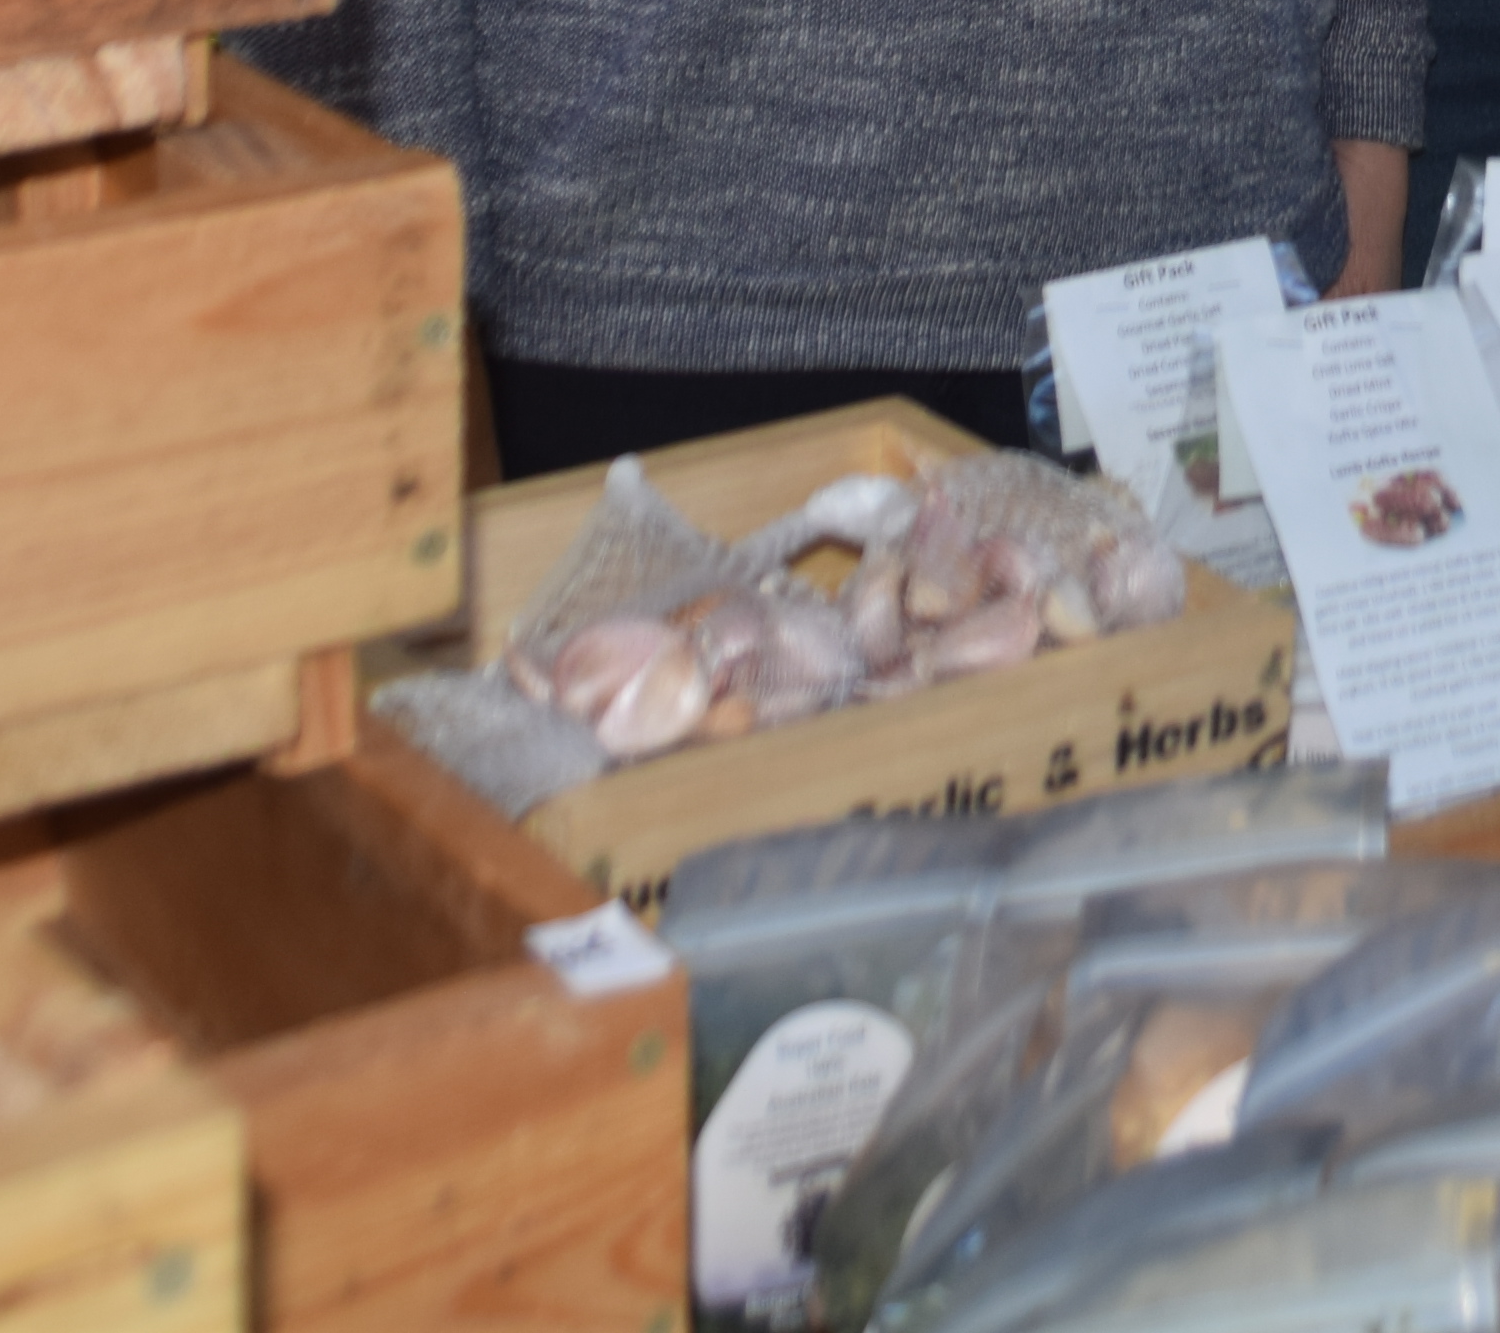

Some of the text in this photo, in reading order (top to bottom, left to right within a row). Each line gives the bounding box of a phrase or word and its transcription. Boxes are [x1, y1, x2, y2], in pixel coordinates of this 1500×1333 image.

[1124, 259, 1196, 290] Gift Pack
[1303, 301, 1379, 333] Gift Pack
[1044, 741, 1080, 795] &
[1114, 695, 1268, 773] Herbs
